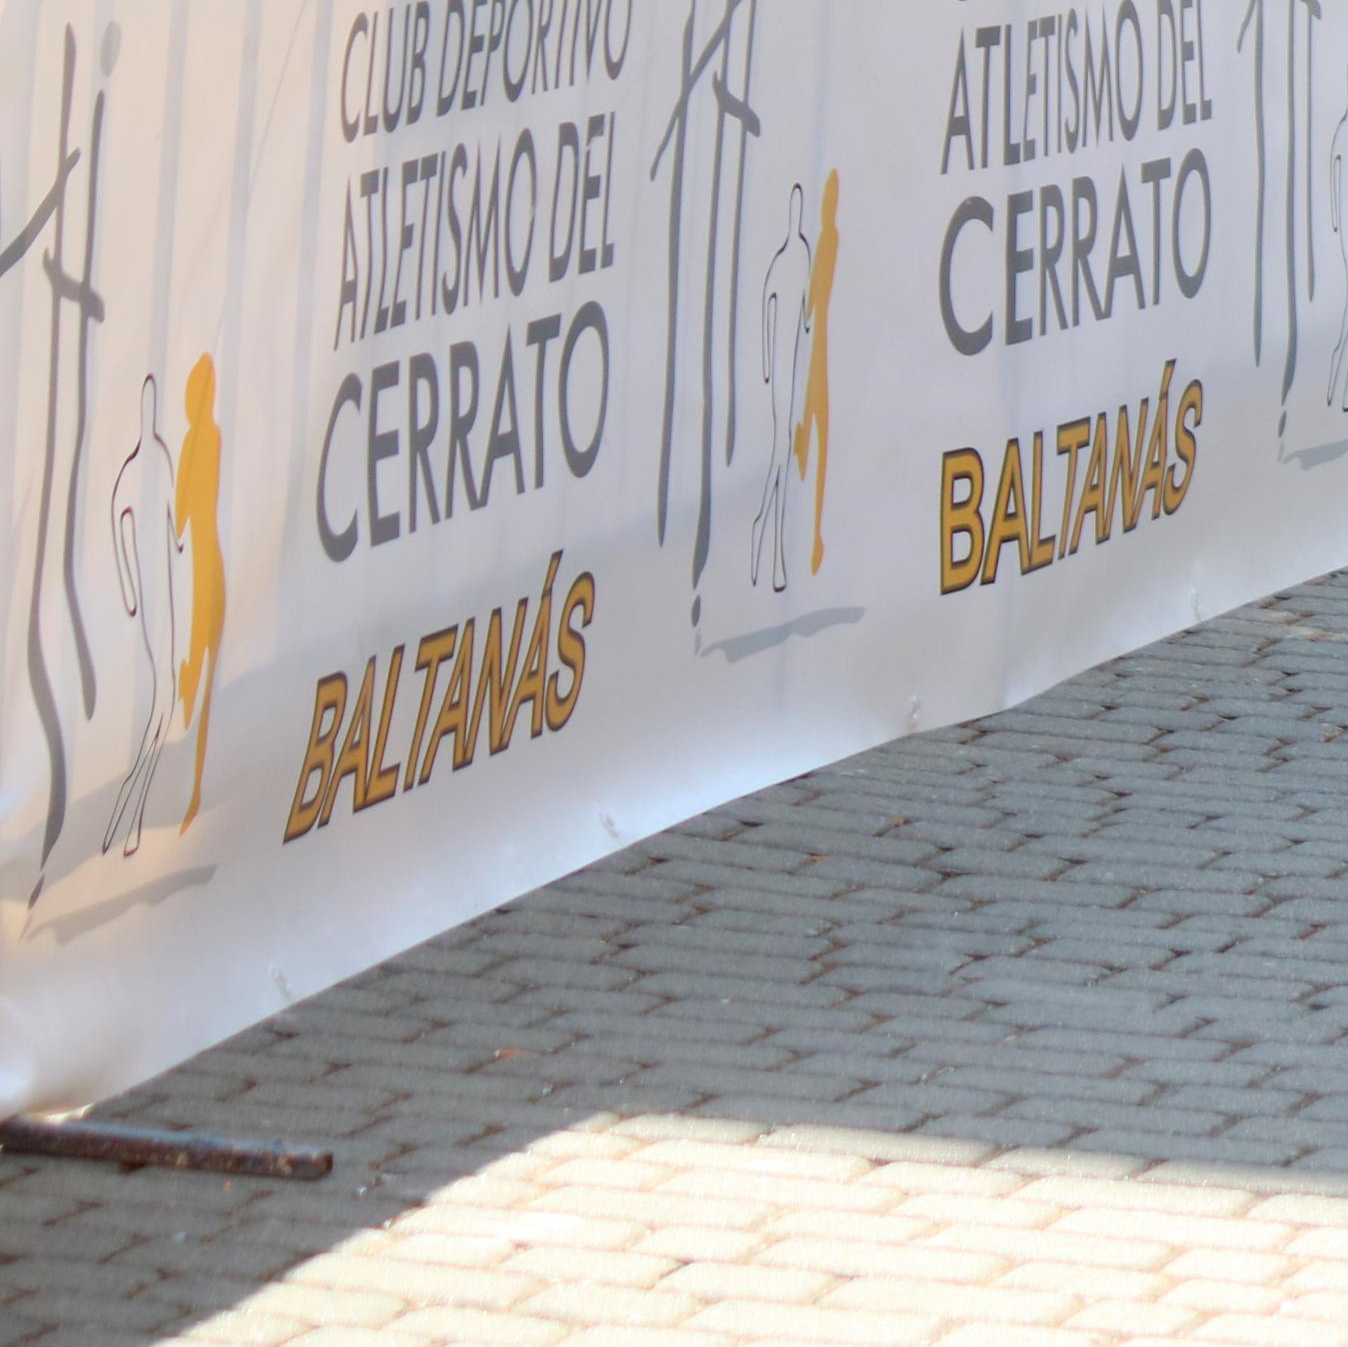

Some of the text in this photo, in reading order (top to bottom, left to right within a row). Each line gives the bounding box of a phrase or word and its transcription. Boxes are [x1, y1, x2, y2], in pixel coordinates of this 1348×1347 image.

[340, 0, 430, 143] CLUB
[334, 111, 615, 352] ATLETISMO DEL
[938, 148, 1211, 356] CERRATO
[316, 300, 609, 562] CERRATO
[940, 358, 1203, 595] BALTANÁS
[282, 548, 595, 845] BALTANÁS
